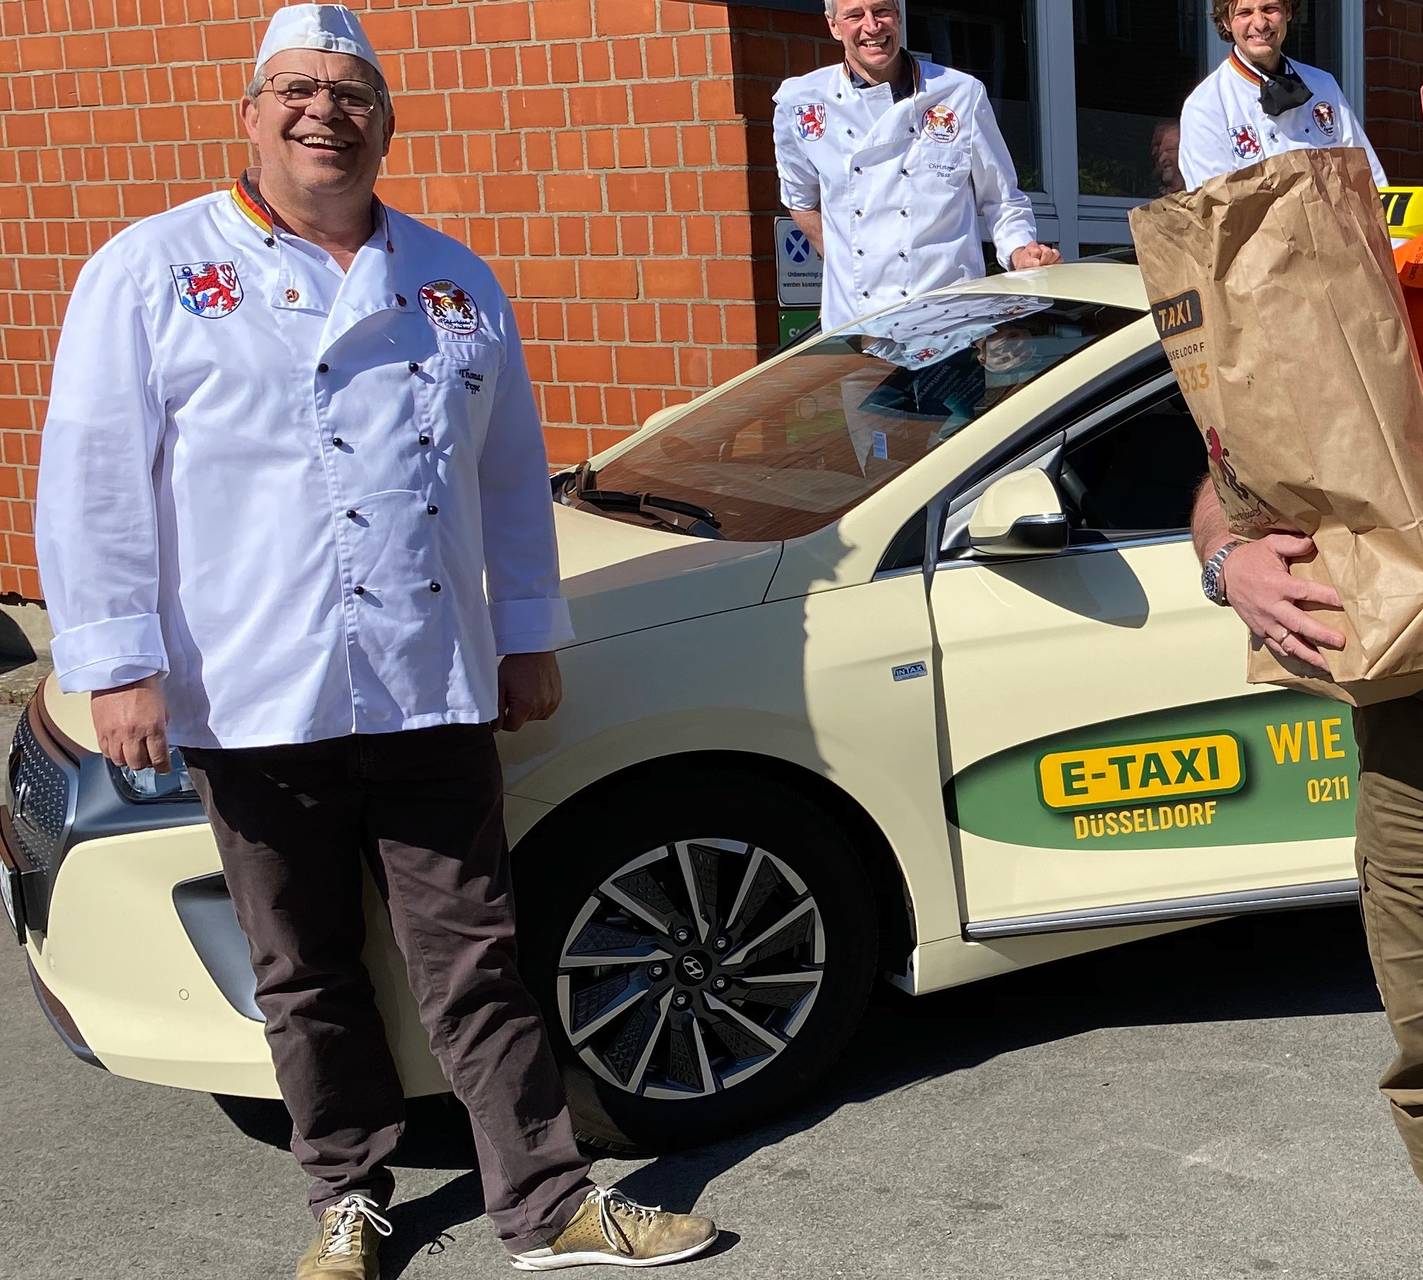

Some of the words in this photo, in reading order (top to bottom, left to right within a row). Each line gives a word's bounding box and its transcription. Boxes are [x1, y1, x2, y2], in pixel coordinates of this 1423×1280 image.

[1158, 299, 1192, 332] TAXI
[1168, 342, 1205, 361] SSELDORF
[1176, 362, 1210, 394] 333
[1265, 718, 1346, 765] WIE
[1060, 745, 1221, 798] E-TAXI
[1306, 775, 1350, 803] 0211
